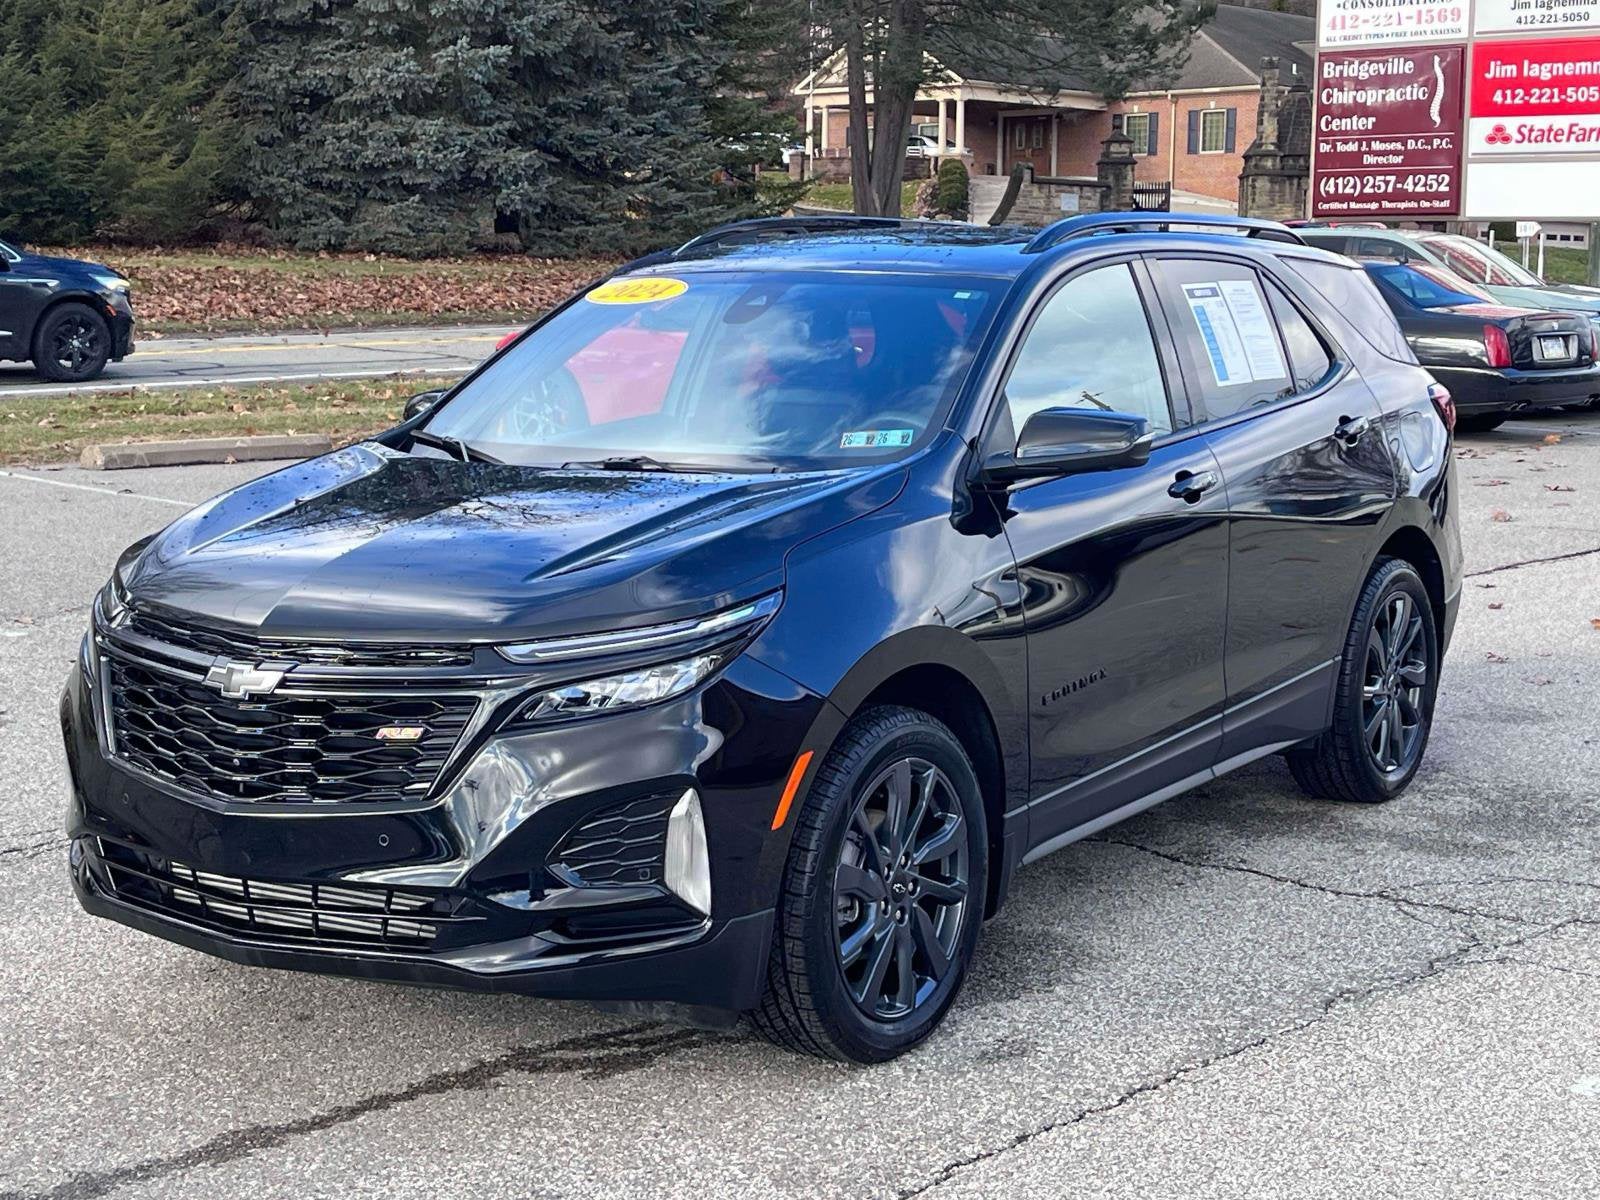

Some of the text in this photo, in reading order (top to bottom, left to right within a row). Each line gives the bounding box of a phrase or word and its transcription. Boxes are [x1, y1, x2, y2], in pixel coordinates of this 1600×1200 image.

[1510, 0, 1531, 10] Jim
[1327, 7, 1462, 31] 412-221-1569
[1516, 12, 1590, 25] 412-221-5050
[1339, 34, 1363, 42] CREDIT
[1323, 57, 1415, 80] Bridgeville
[1484, 60, 1518, 79] Jim
[1321, 83, 1429, 106] Chiropractic
[1493, 86, 1600, 104] 412-221-505
[1320, 114, 1376, 132] Center
[1320, 142, 1334, 153] Dr.
[1336, 141, 1359, 152] Todd
[1361, 141, 1369, 151] J.
[1371, 140, 1405, 151] Moses,
[1433, 138, 1453, 149] P.C.
[1363, 154, 1404, 165] Director
[1318, 199, 1450, 210] Certified Massage Therapists On-Staff
[597, 283, 679, 299] 2024
[1041, 666, 1107, 706] EQUINOX
[375, 727, 424, 740] RS
